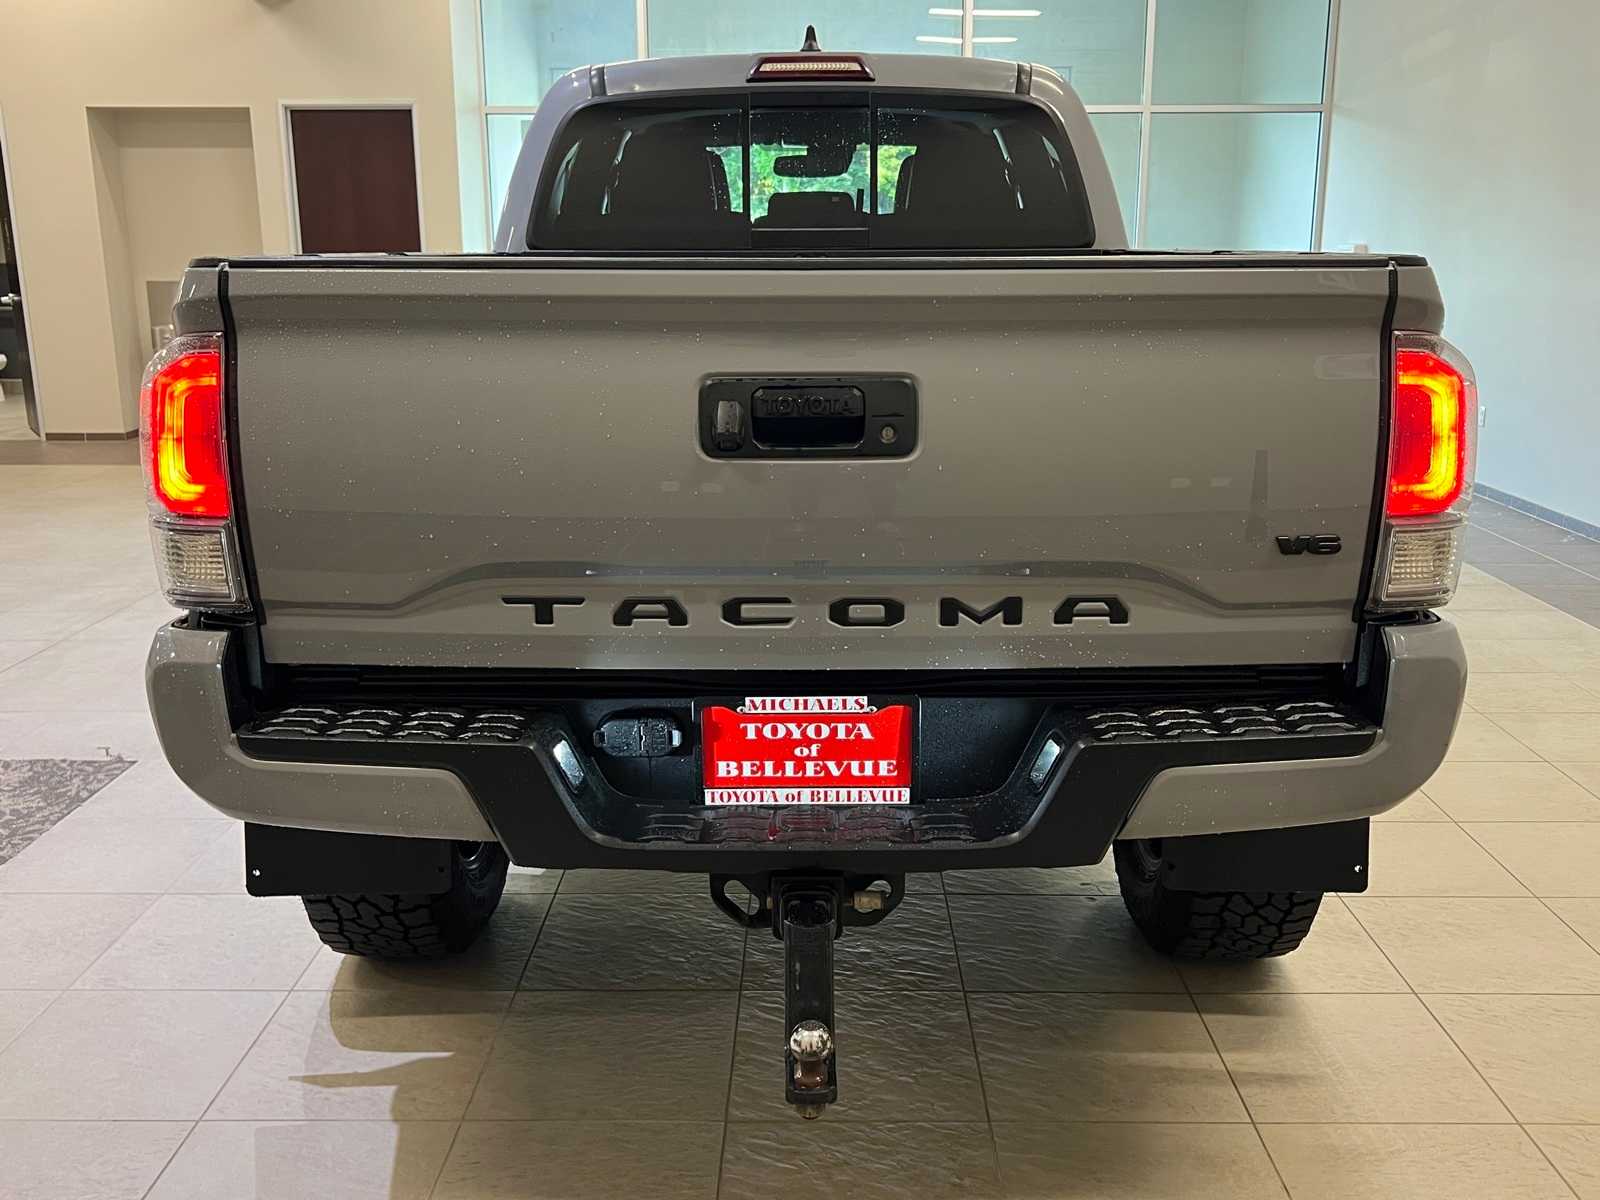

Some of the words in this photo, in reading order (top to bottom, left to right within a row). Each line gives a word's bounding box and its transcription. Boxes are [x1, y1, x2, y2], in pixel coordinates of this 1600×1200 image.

[761, 396, 857, 416] TOYOTA
[1276, 534, 1342, 555] V6
[501, 596, 1130, 628] TACOMA
[748, 697, 866, 712] MICHAELS
[739, 722, 875, 740] TOYOTA
[793, 743, 821, 757] of
[716, 760, 898, 778] BELLEVUE
[706, 789, 779, 804] TOYOTA
[785, 789, 803, 803] of
[808, 788, 908, 803] BELLEVUE
